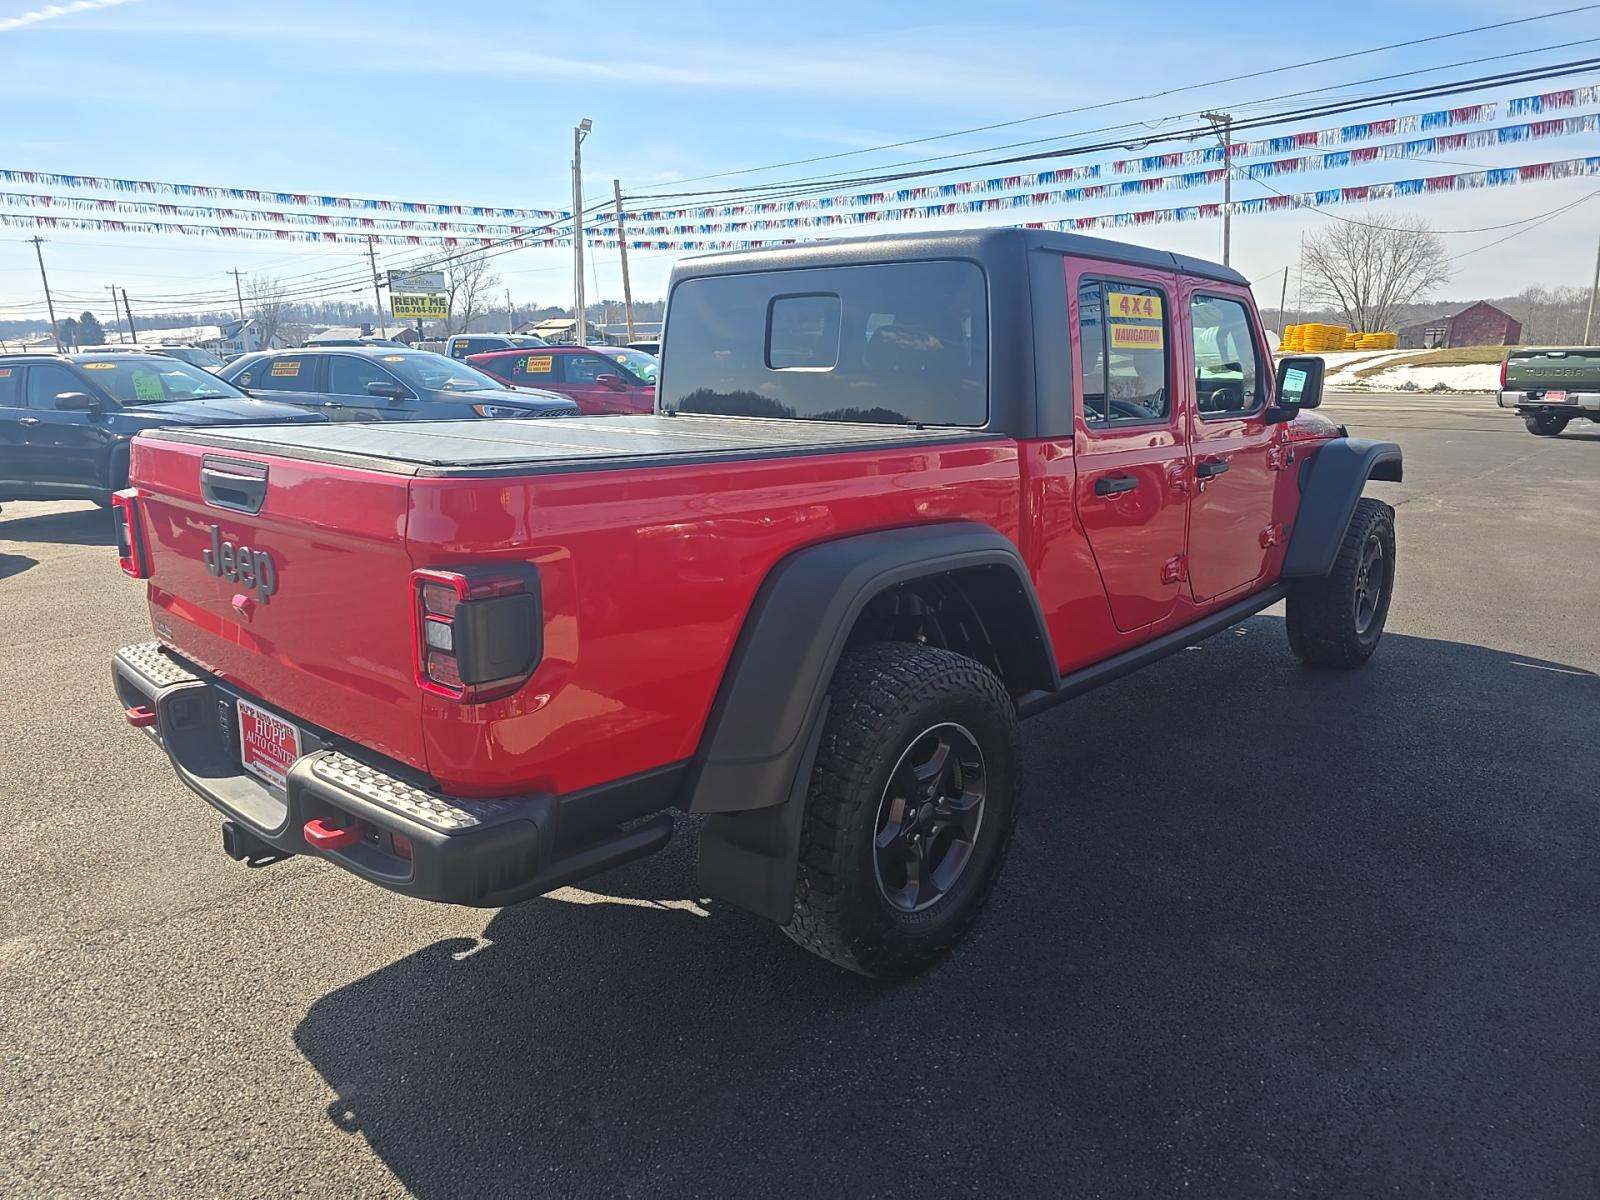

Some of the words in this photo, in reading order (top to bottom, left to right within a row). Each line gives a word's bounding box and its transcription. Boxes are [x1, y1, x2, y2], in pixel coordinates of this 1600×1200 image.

[394, 296, 427, 306] RENT
[429, 297, 446, 306] ME
[1115, 328, 1160, 343] NAVIGATION
[1525, 368, 1584, 377] TUNDRA
[203, 524, 275, 605] Jeep
[245, 730, 267, 749] AUTO
[267, 741, 296, 765] CENTER
